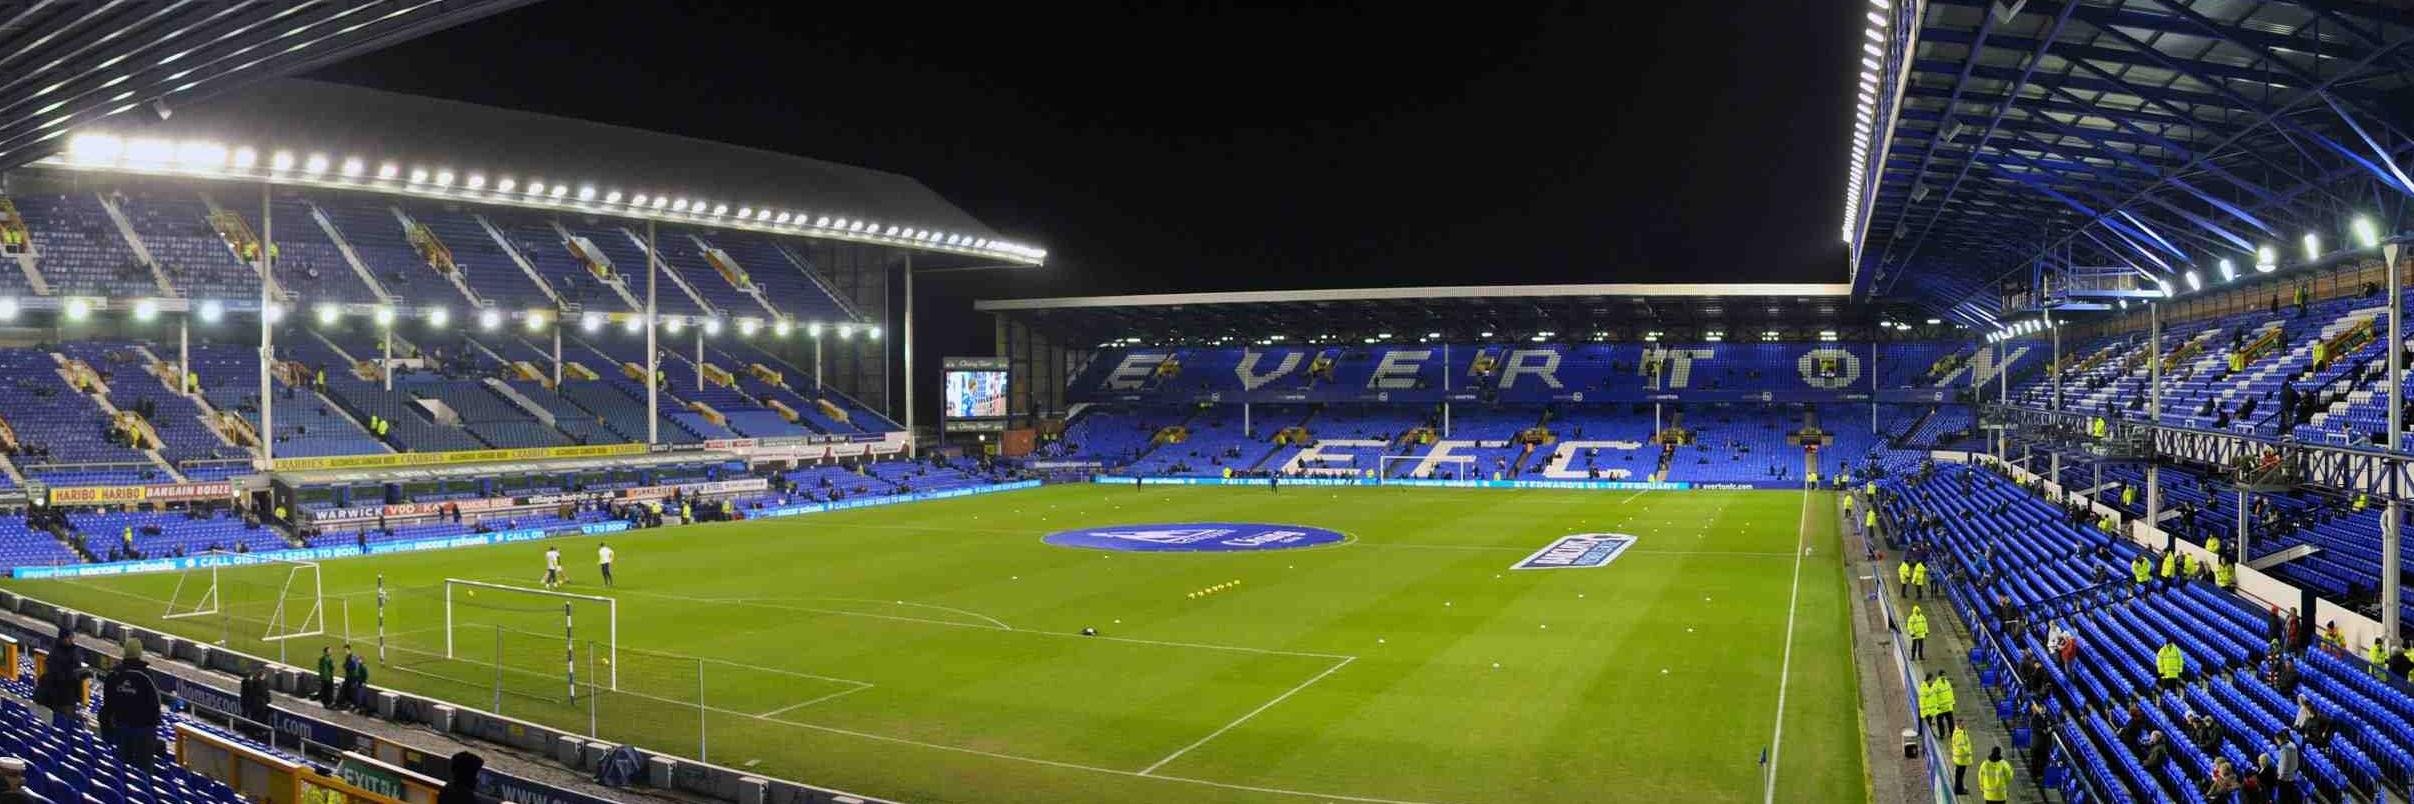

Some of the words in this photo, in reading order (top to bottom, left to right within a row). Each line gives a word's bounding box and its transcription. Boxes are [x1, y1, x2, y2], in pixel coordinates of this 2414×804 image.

[1103, 346, 2031, 391] EVERTON
[1281, 438, 1643, 478] EFC
[146, 486, 195, 498] BARGAIN
[196, 484, 231, 497] BOOZE
[1620, 480, 1679, 489] FEBRUARY
[56, 488, 96, 501] HARIBO
[101, 487, 141, 500] HARIBO
[316, 507, 383, 520] WARWICK
[200, 554, 232, 567] CALL
[318, 548, 333, 558] TO
[344, 767, 380, 794] EXIT
